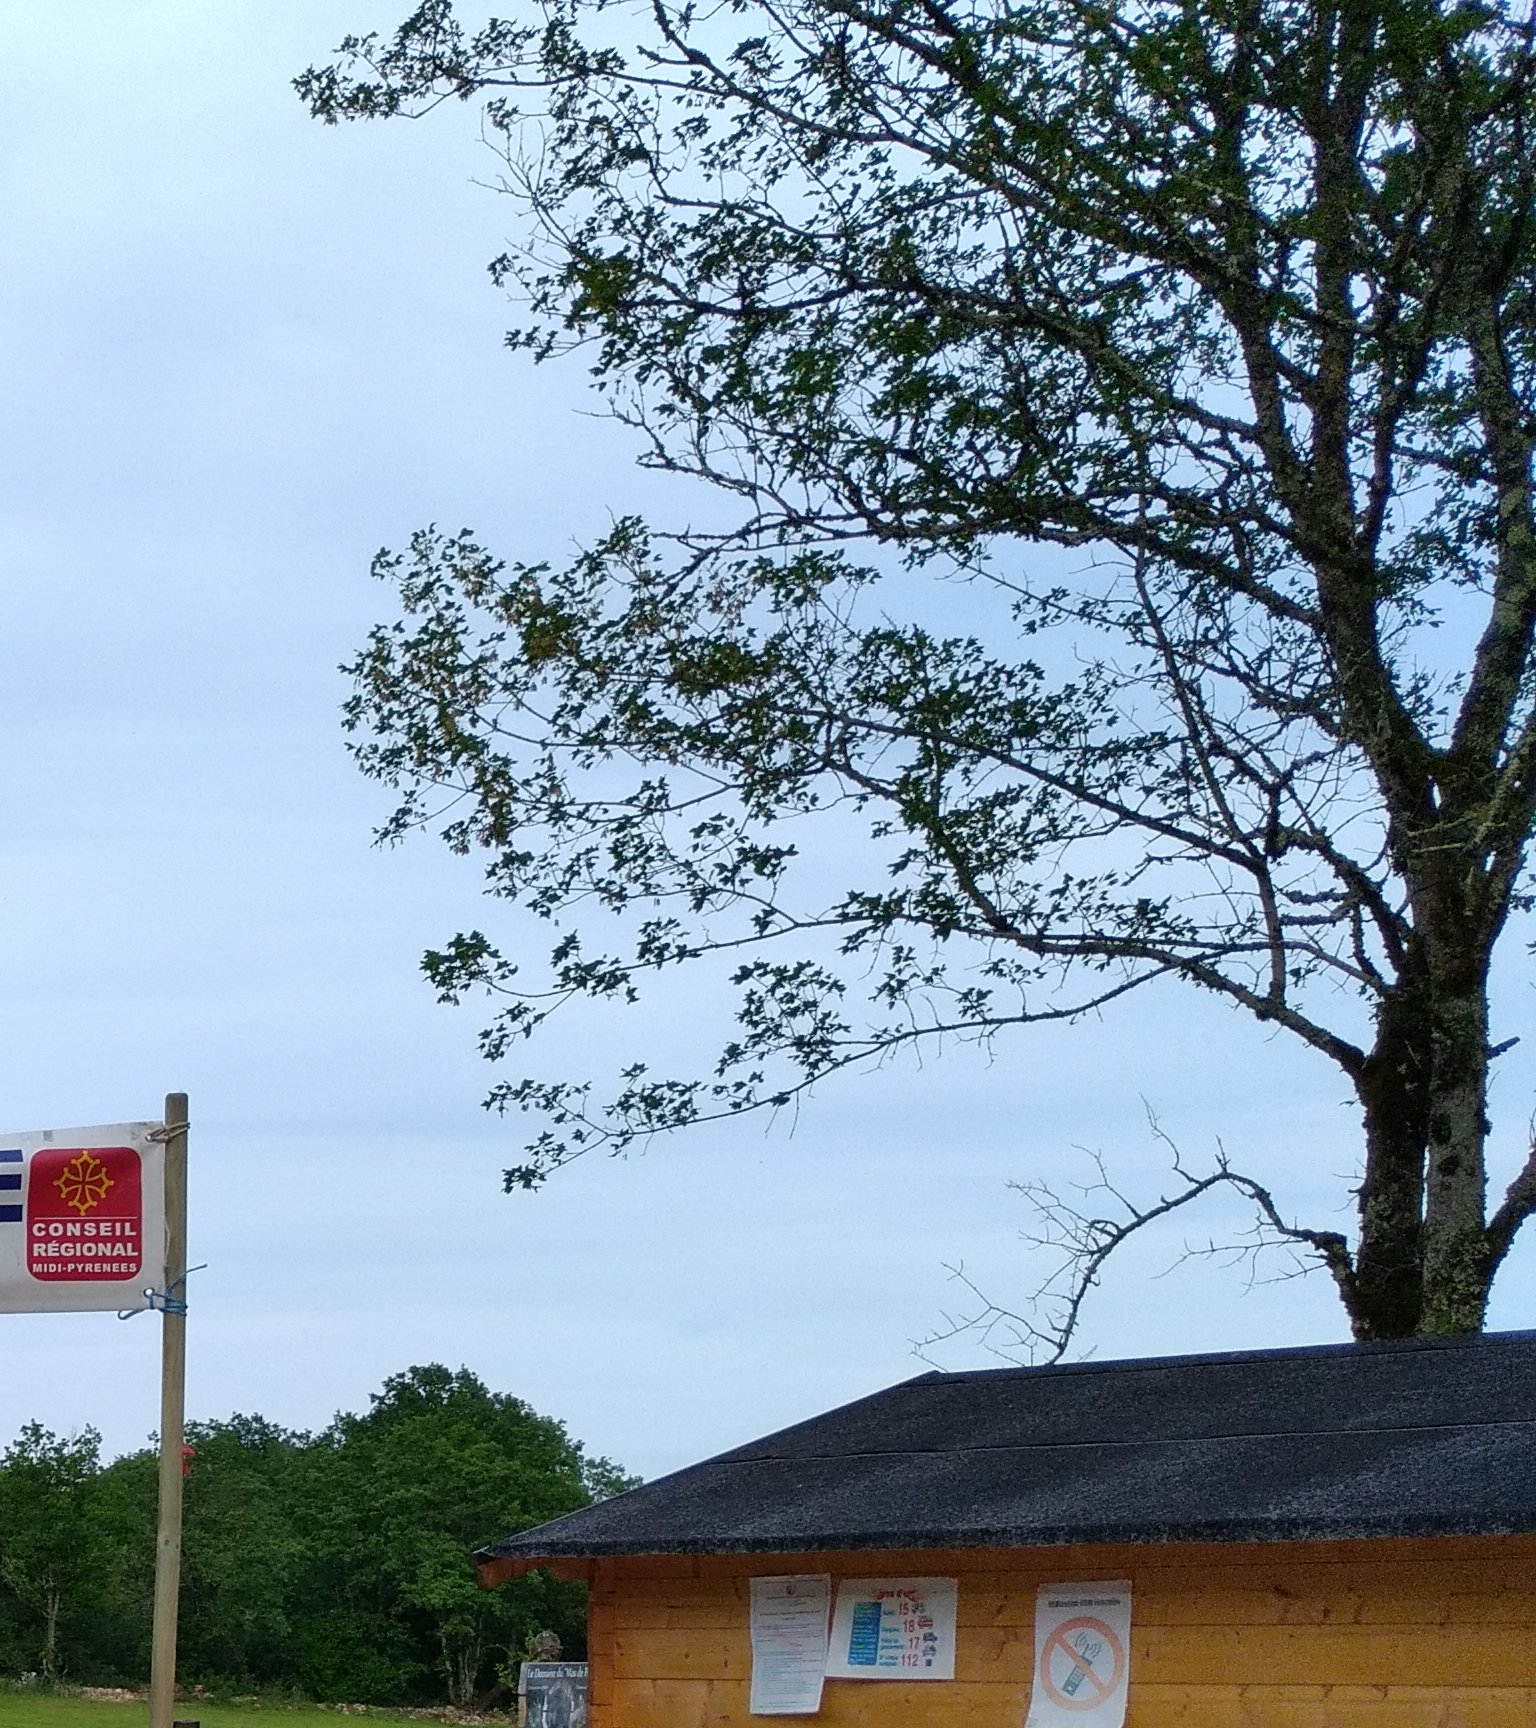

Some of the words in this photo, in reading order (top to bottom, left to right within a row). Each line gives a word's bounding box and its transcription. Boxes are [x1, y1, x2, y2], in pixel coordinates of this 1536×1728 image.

[32, 1222, 137, 1236] CONSEIL
[32, 1240, 138, 1257] RÉGIONAL
[32, 1262, 137, 1273] MIDI-PYRENEES
[903, 1620, 915, 1632] 18
[908, 1637, 920, 1649] 17
[901, 1654, 920, 1666] 112
